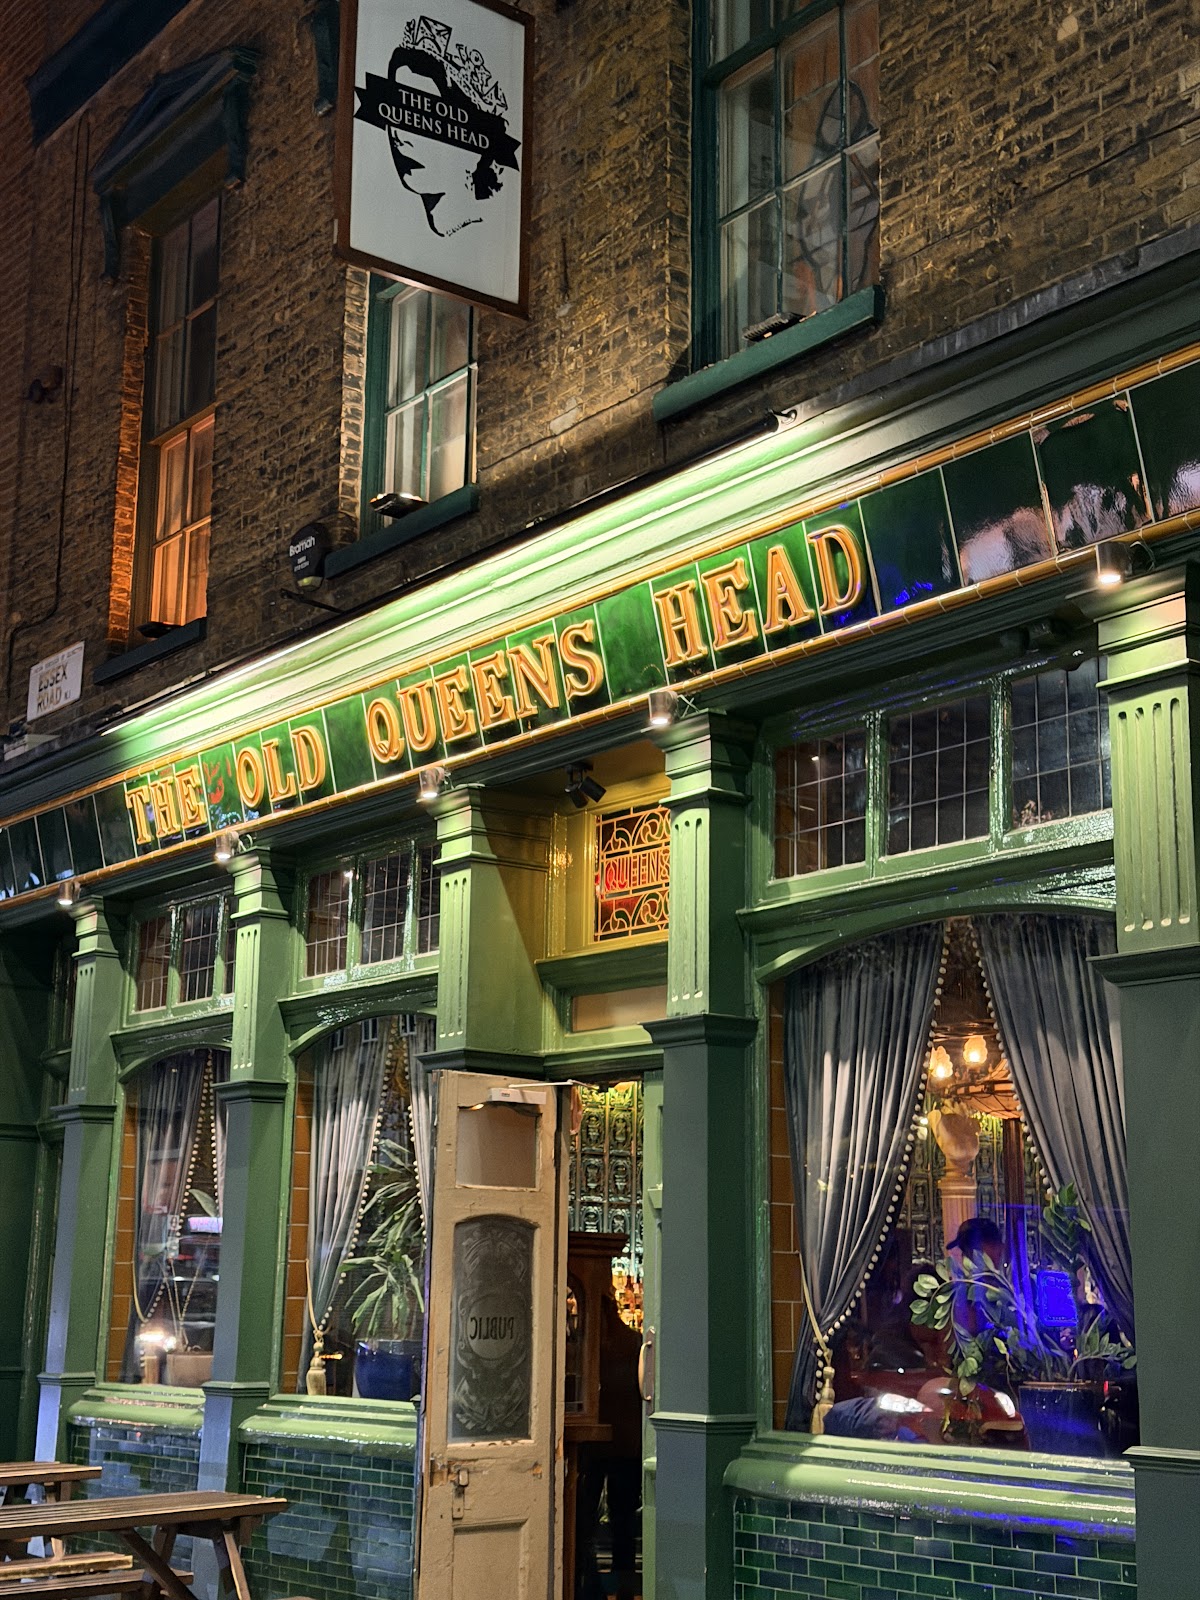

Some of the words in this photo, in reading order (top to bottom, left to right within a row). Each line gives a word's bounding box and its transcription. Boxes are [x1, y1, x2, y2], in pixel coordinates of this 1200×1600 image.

[378, 102, 442, 135] QUEENS
[447, 123, 490, 149] HEAD
[399, 88, 432, 113] THE
[435, 101, 469, 124] OLD
[125, 764, 208, 845] THE
[236, 724, 327, 809] OLD
[366, 618, 605, 764] QUEENS
[653, 523, 867, 668] HEAD
[604, 848, 670, 893] QUEENS
